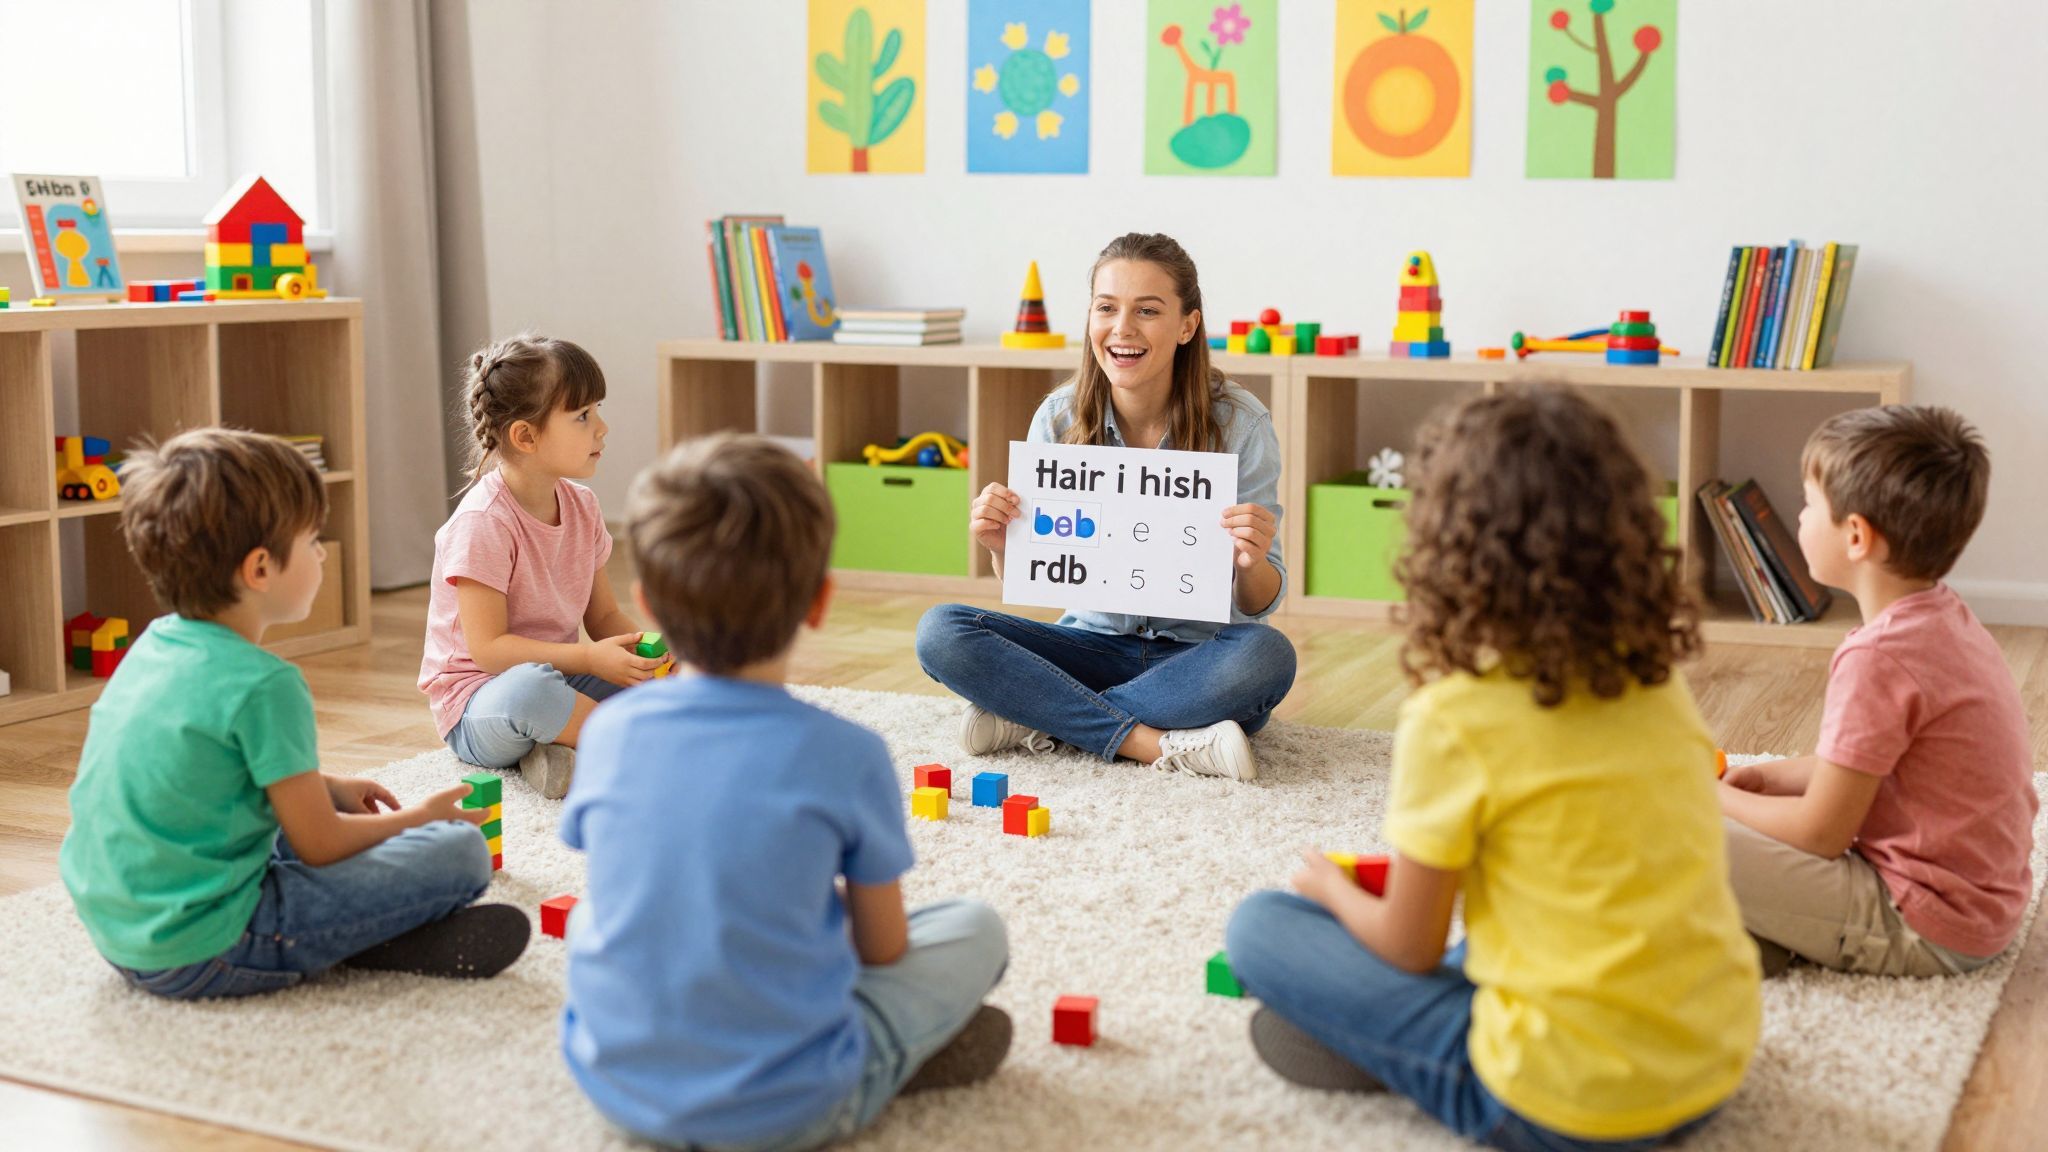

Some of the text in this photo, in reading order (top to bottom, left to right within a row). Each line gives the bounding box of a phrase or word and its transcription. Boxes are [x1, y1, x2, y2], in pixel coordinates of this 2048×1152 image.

[1036, 459, 1212, 500] Hair i hish
[1034, 507, 1096, 539] beb
[1133, 522, 1150, 542] e
[1030, 554, 1087, 585] rdb
[1130, 569, 1145, 590] 5
